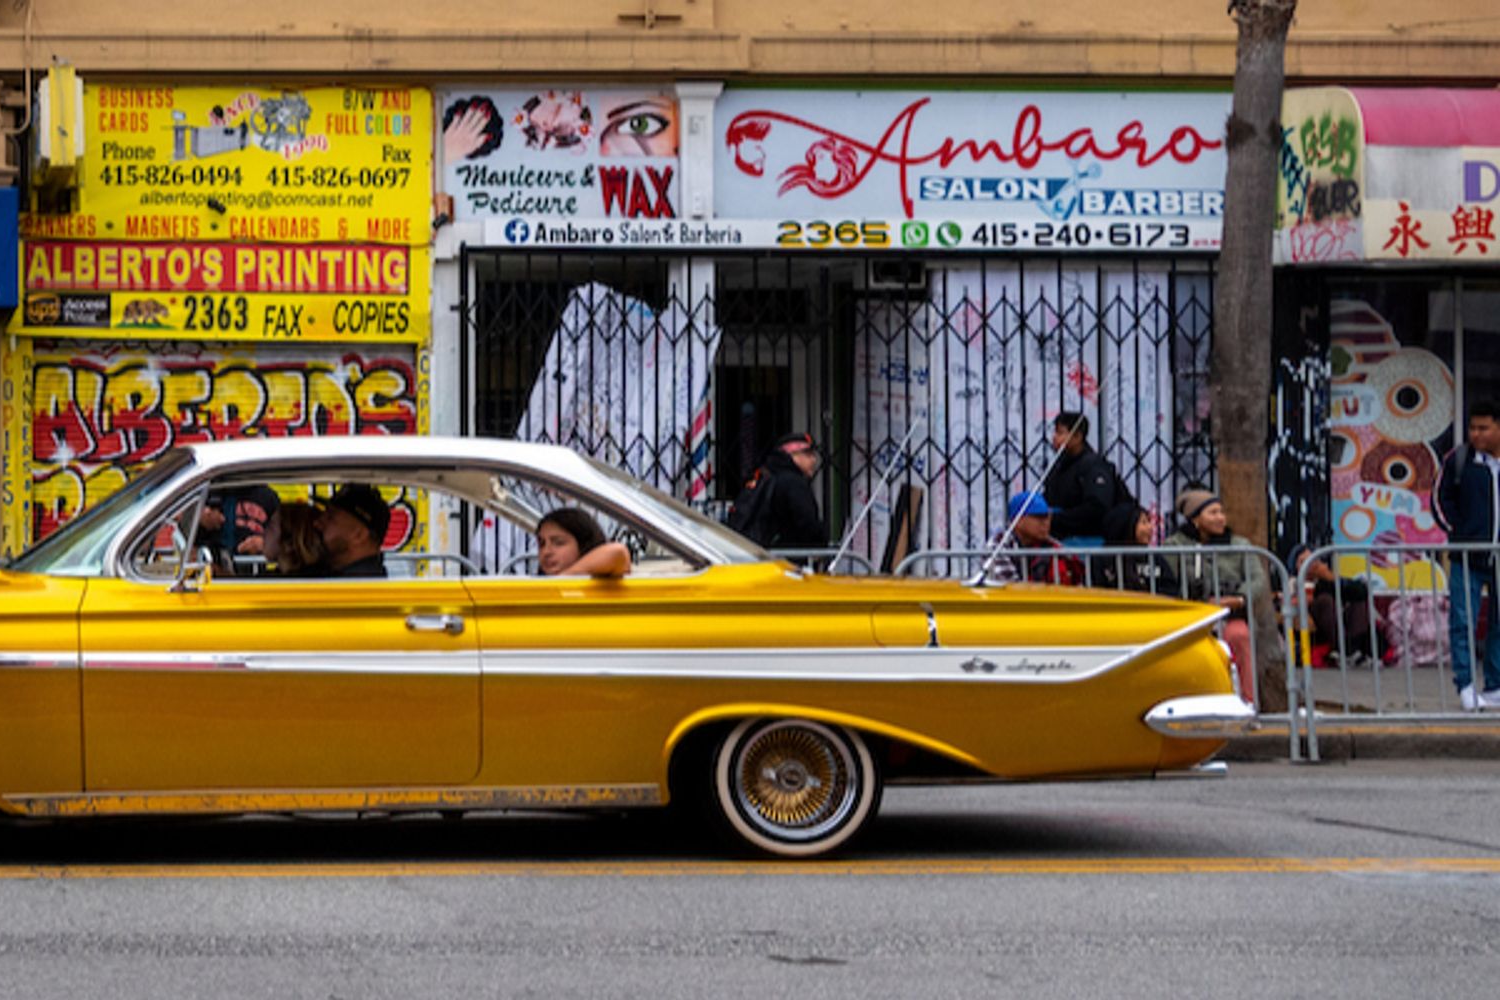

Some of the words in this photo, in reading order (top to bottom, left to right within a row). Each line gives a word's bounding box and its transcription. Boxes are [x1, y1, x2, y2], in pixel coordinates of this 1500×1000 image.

[99, 89, 175, 109] BUSINESS
[343, 90, 376, 109] B/W
[381, 89, 411, 110] AND
[99, 113, 149, 133] CARDS
[326, 113, 359, 134] FULL
[365, 114, 412, 135] COLOR
[102, 142, 156, 161] Phone
[382, 144, 412, 163] Fax
[456, 164, 576, 187] Manicure
[580, 164, 596, 187] &
[598, 165, 676, 219] WAX
[922, 178, 1049, 200] SALON
[467, 192, 579, 216] Pedicure
[1082, 191, 1224, 215] BARBER
[24, 215, 97, 237] BANNERS
[126, 217, 200, 238] MAGNETS
[229, 217, 320, 240] CALENDARS
[367, 219, 411, 241] MORE
[534, 223, 615, 243] Ambaro
[618, 223, 660, 243] Salon
[679, 223, 742, 244] Barberia
[776, 222, 891, 249] 2365
[27, 247, 225, 286] ALBERTO'S
[236, 249, 407, 287] PRINTING
[184, 295, 249, 331] 2363
[263, 305, 305, 337] FAX
[333, 301, 411, 334] COPIES
[2, 351, 14, 506] COPIES
[1360, 485, 1415, 514] YUM
